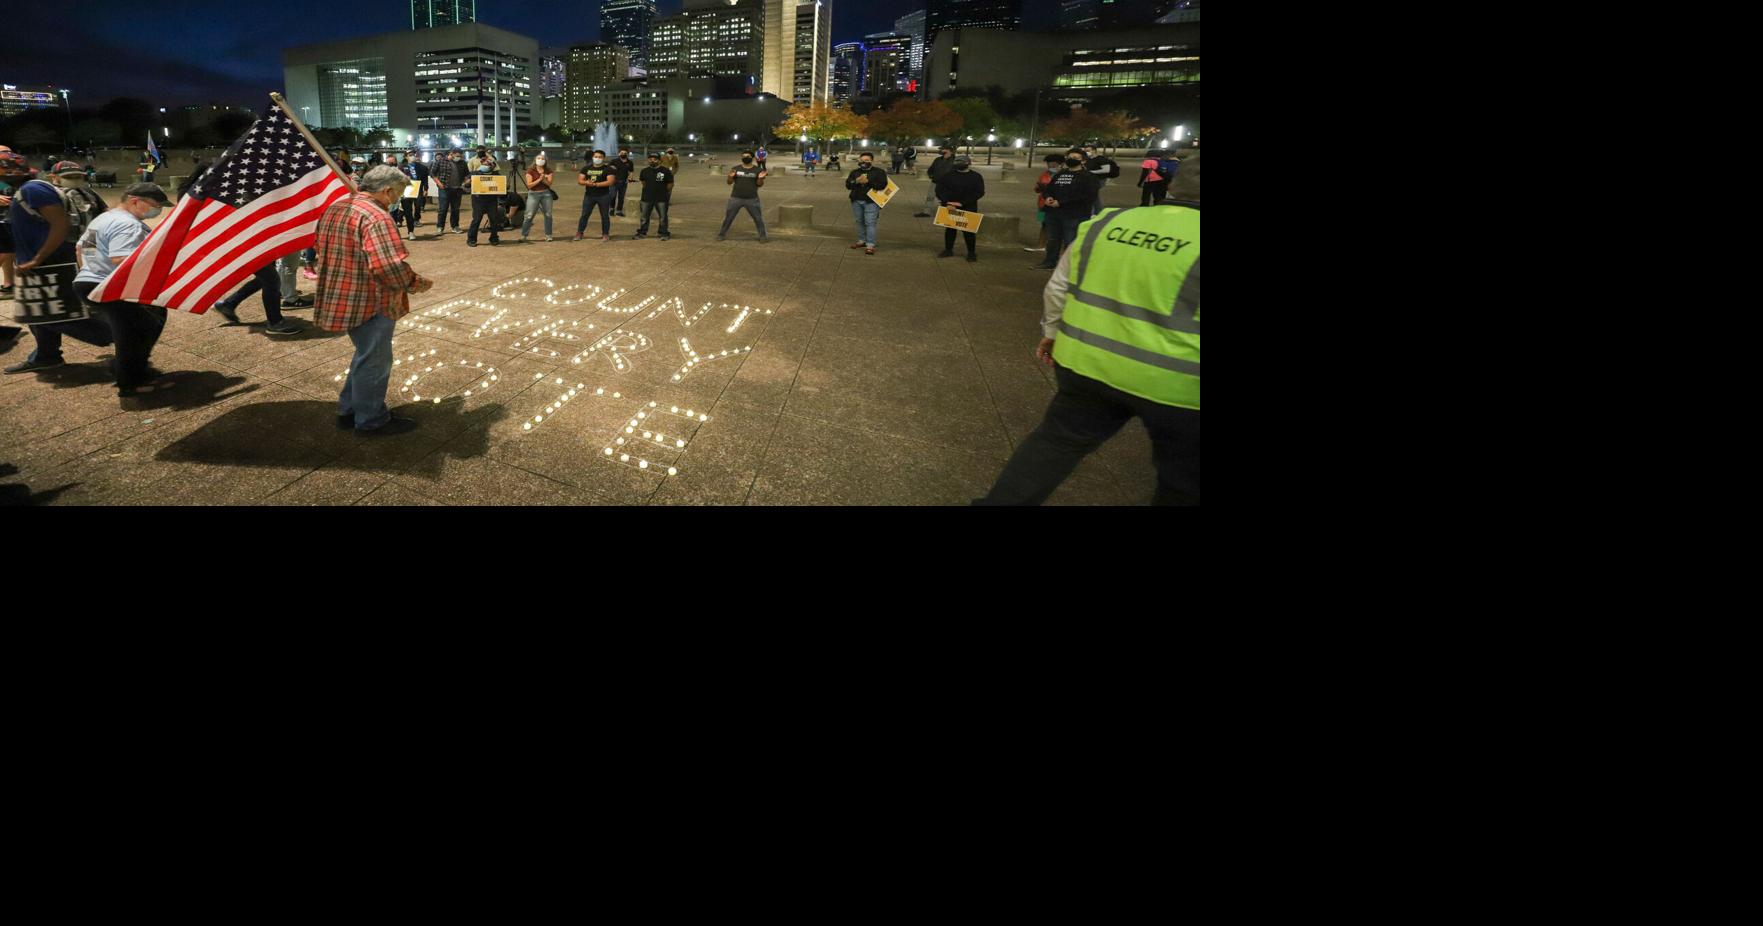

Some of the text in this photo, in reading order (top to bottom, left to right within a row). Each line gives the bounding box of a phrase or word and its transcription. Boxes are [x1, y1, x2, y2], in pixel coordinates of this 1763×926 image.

[1106, 227, 1191, 255] CLERGY
[491, 278, 773, 334] COUNT
[401, 299, 752, 384] EVERY
